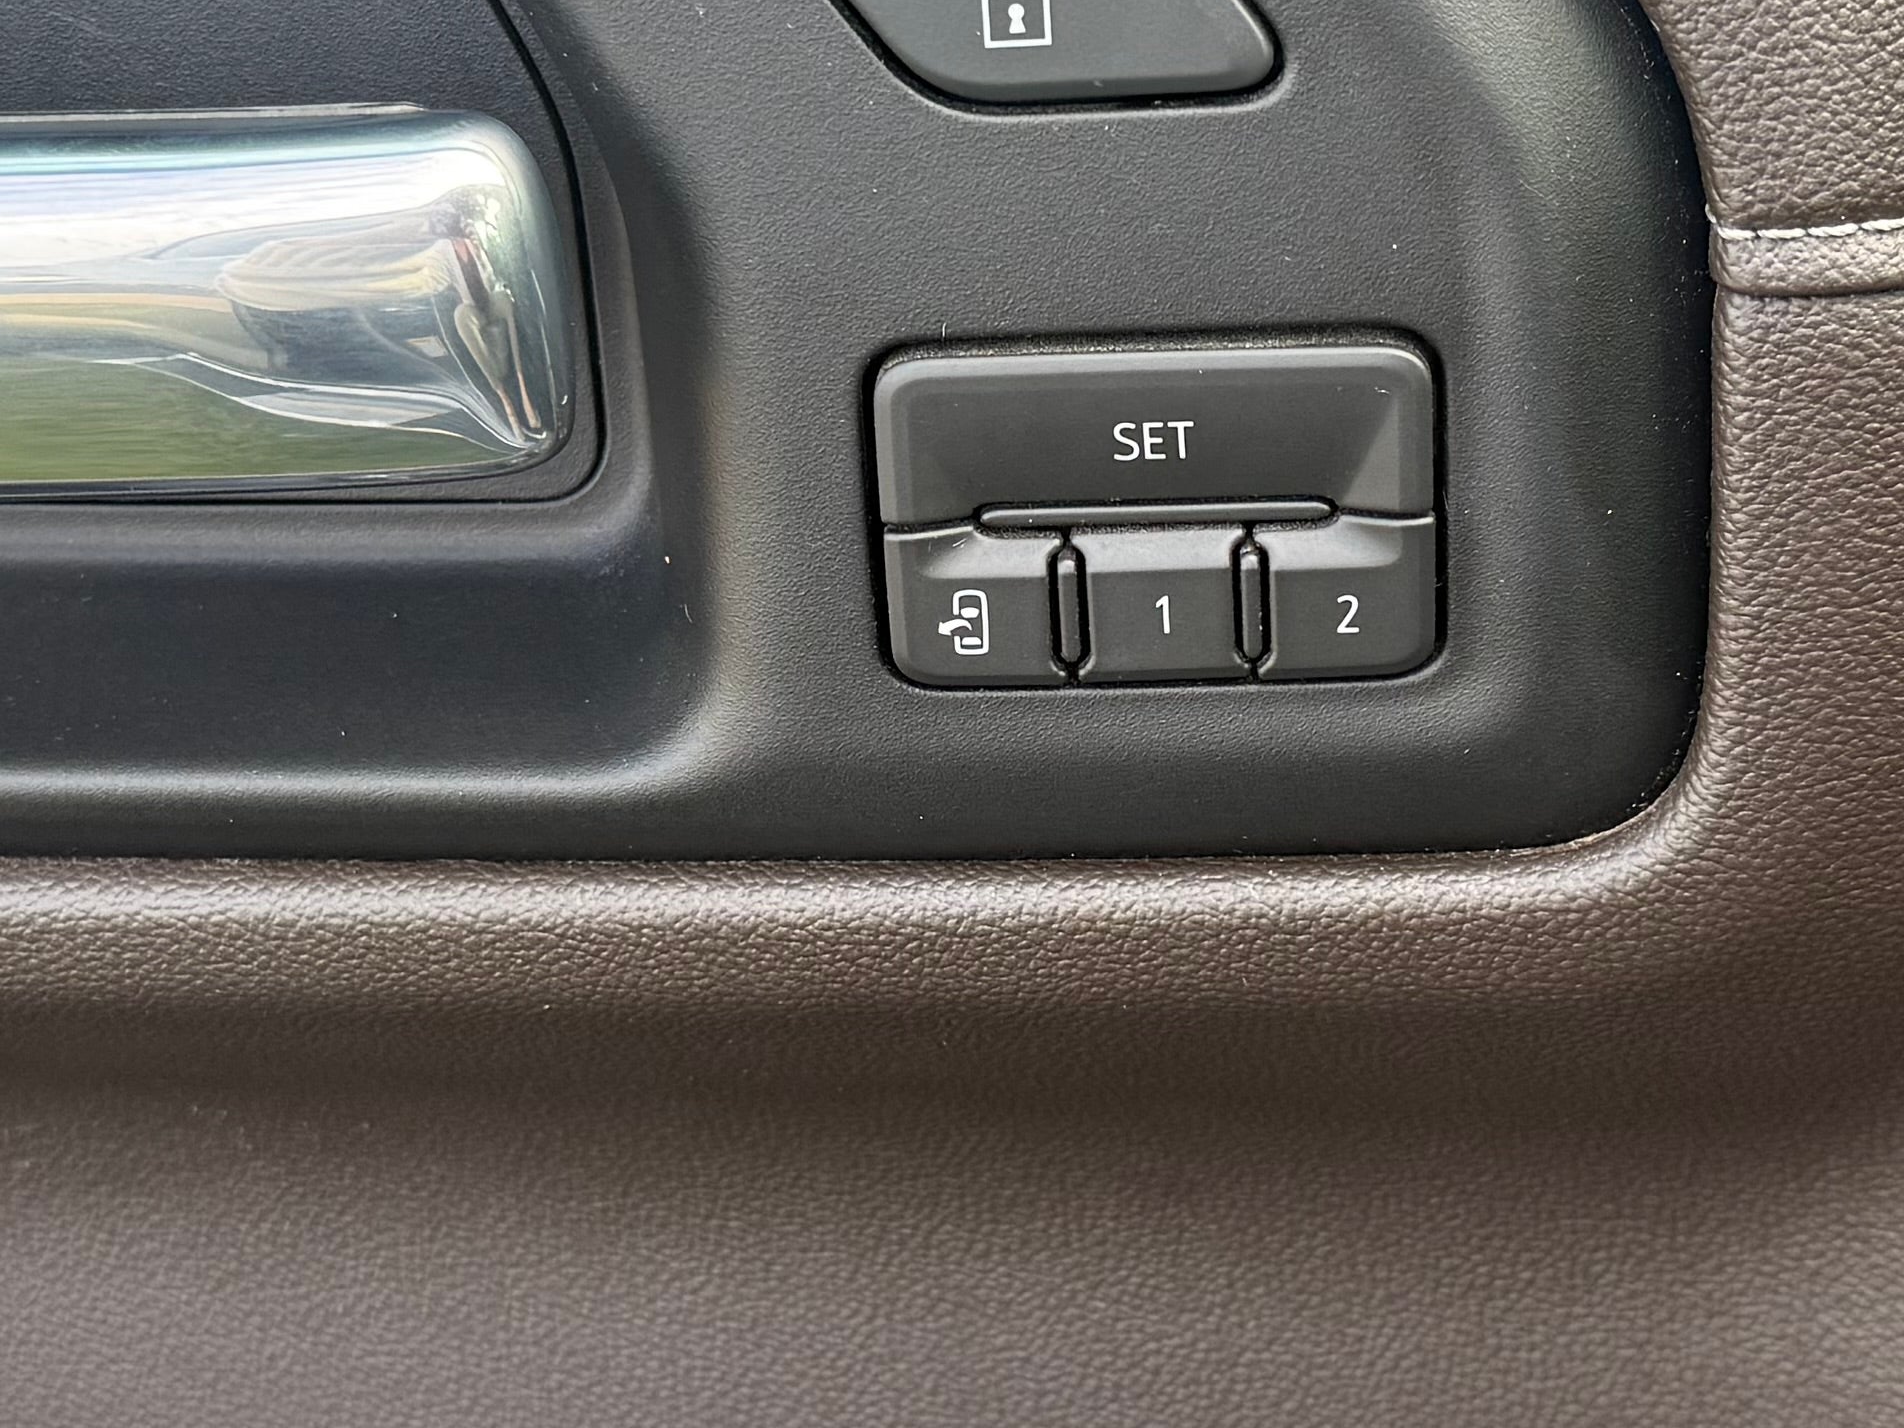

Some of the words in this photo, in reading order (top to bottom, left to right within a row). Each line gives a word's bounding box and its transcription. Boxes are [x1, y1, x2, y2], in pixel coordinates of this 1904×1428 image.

[1112, 420, 1195, 461] SET
[1154, 595, 1171, 634] 1
[1336, 594, 1360, 634] 2
